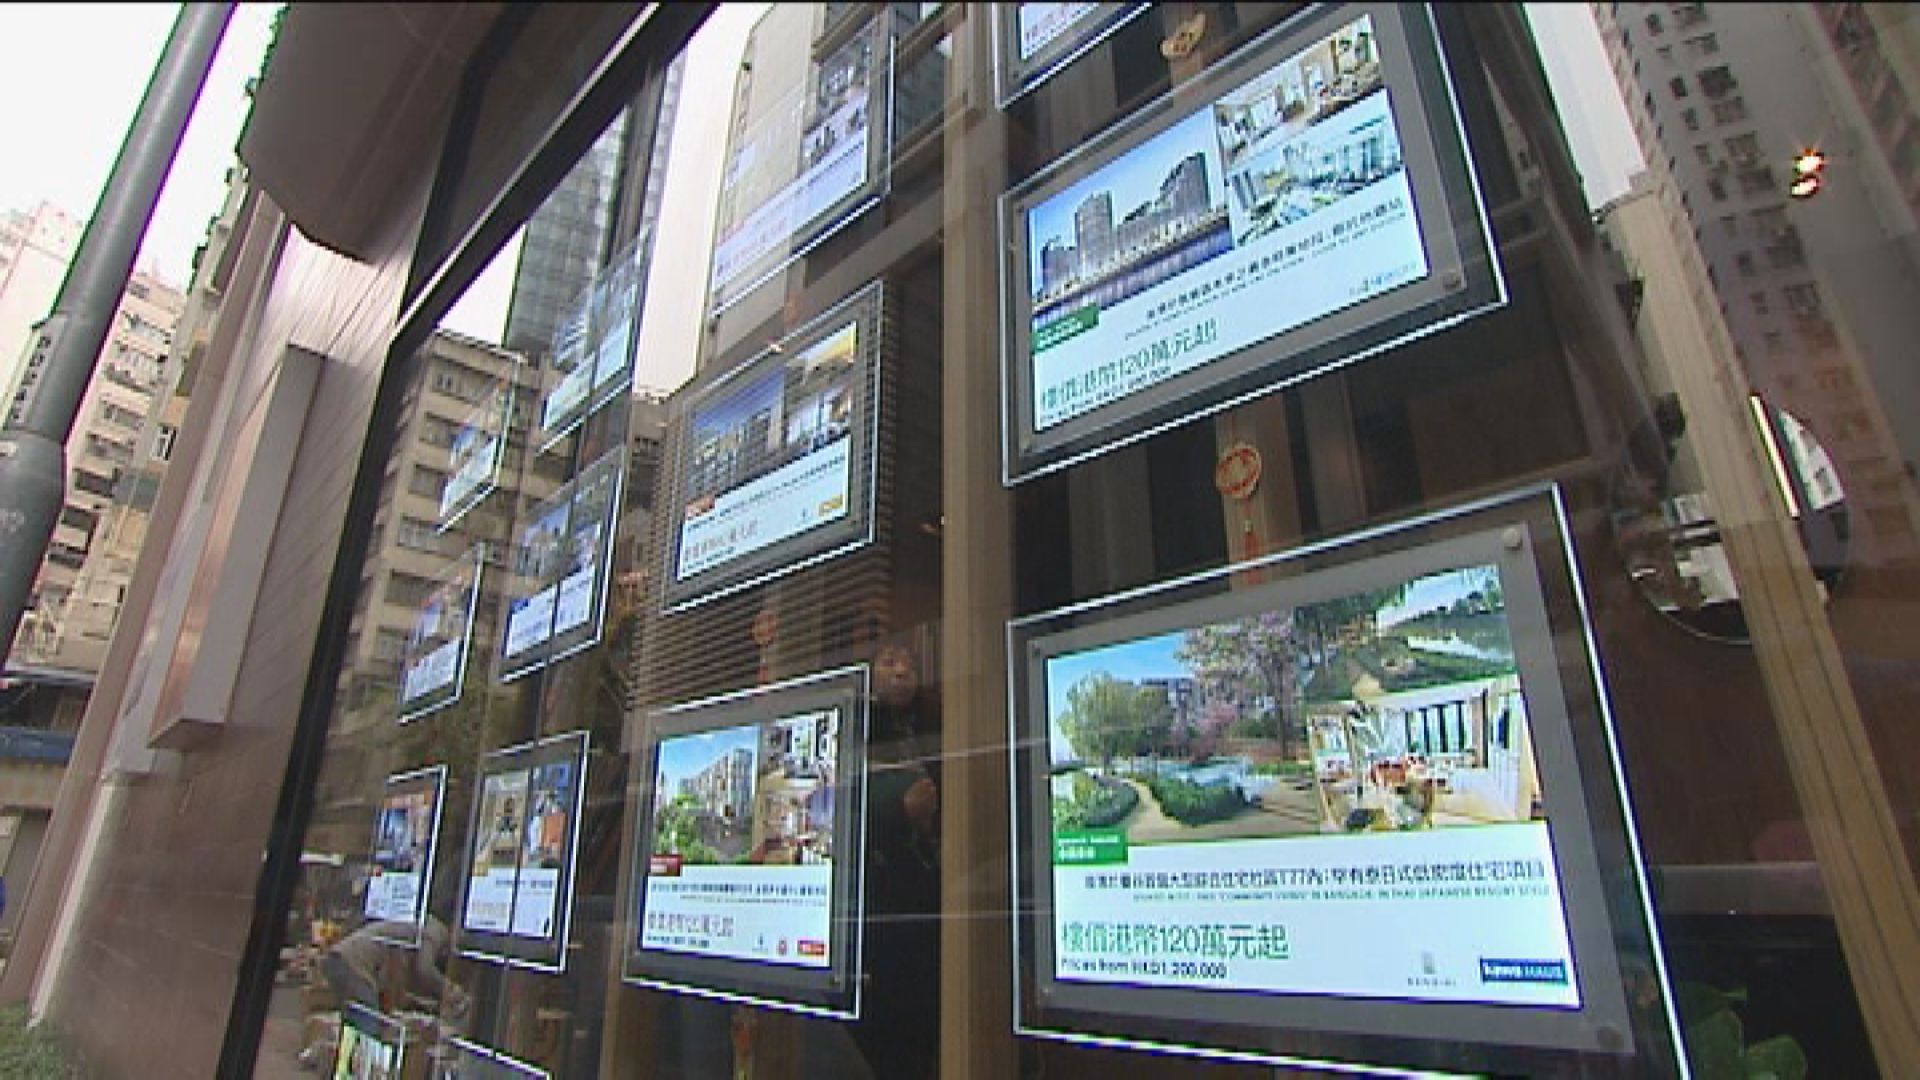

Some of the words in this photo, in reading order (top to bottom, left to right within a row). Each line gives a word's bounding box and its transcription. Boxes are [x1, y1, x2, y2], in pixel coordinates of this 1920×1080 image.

[1062, 921, 1289, 960] 樓價港幣120萬元起
[1098, 958, 1129, 974] from
